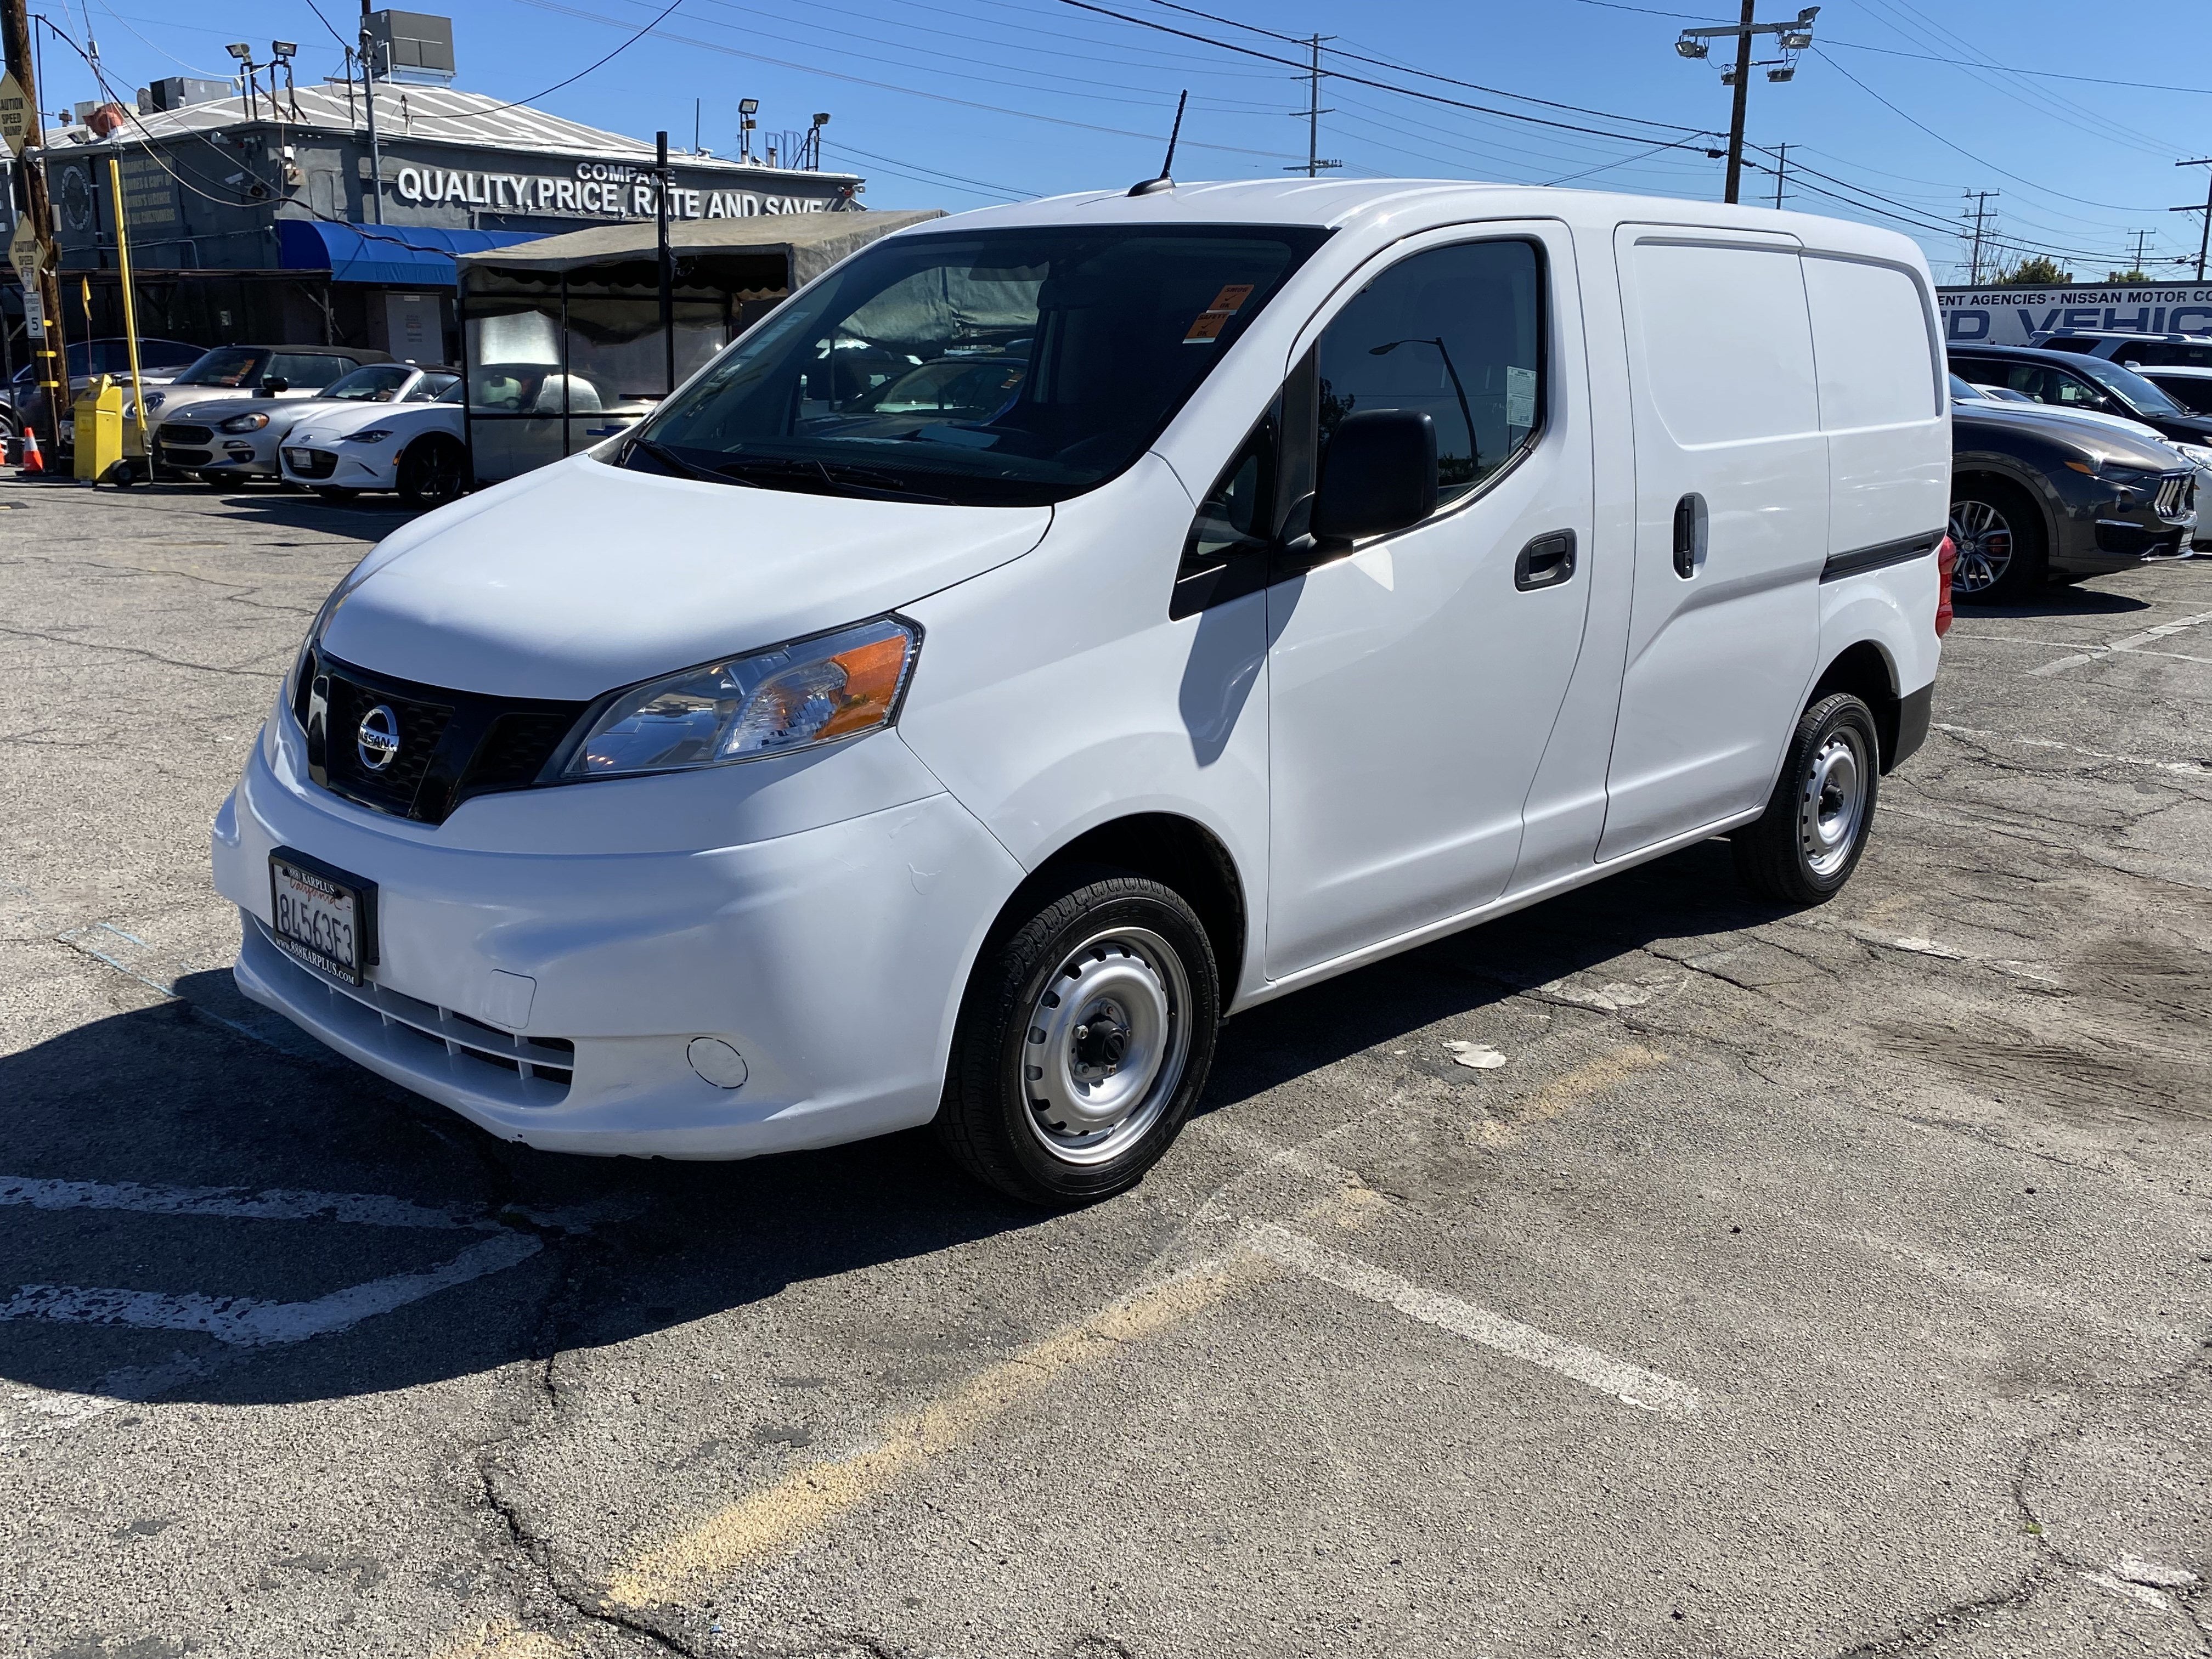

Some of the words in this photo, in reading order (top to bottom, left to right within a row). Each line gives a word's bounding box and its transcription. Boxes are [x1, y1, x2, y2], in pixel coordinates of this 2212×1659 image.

[0, 98, 24, 110] AUTION
[1, 113, 21, 125] SPEED
[4, 126, 22, 137] BUMP
[577, 162, 676, 187] COMPAE
[708, 192, 759, 219] AND
[765, 197, 822, 216] SAVE
[19, 256, 34, 266] SPEED
[1970, 294, 2046, 306] AGENCIES
[2060, 292, 2123, 304] NISSAN
[2127, 291, 2187, 303] MOTOR
[32, 318, 38, 331] 5
[302, 872, 335, 895] KARPLUS
